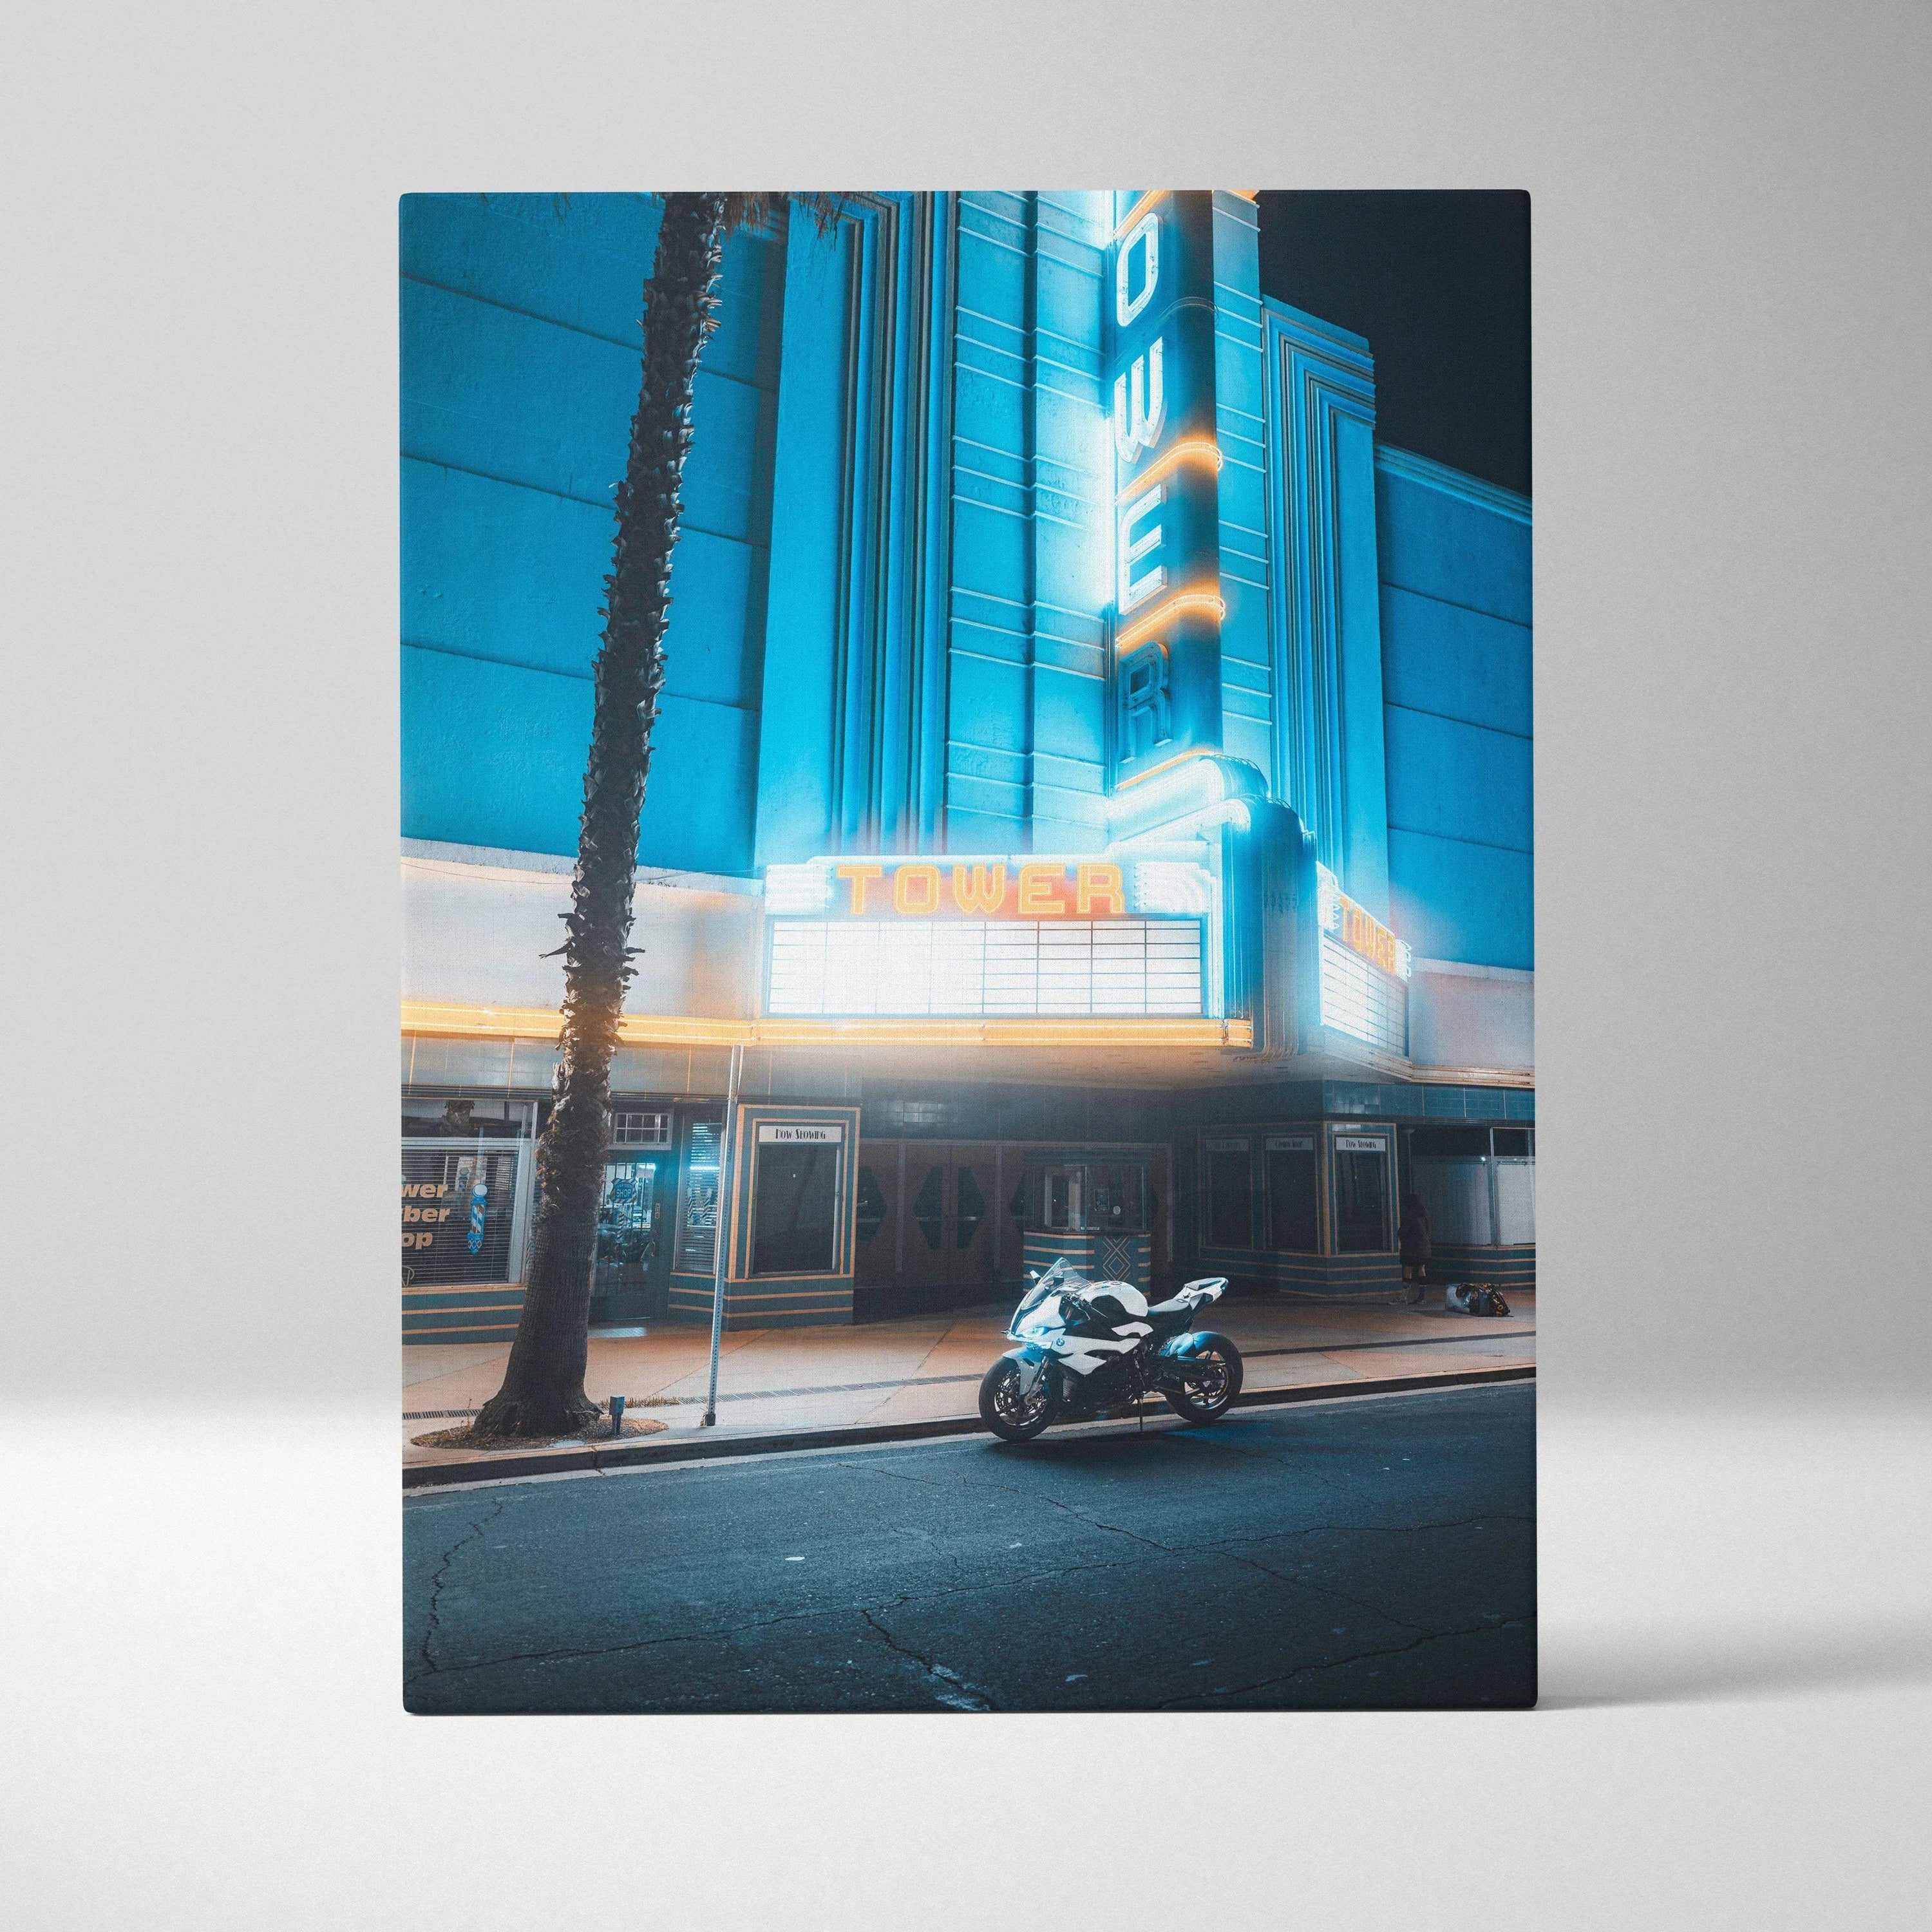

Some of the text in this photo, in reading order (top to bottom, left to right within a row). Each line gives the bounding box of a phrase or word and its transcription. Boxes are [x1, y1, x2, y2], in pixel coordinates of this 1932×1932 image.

[837, 862, 1126, 915] TOWER
[1340, 893, 1397, 977] TOWER
[616, 1189, 632, 1198] SHOP
[402, 1205, 450, 1222] ber
[402, 1232, 433, 1249] op
